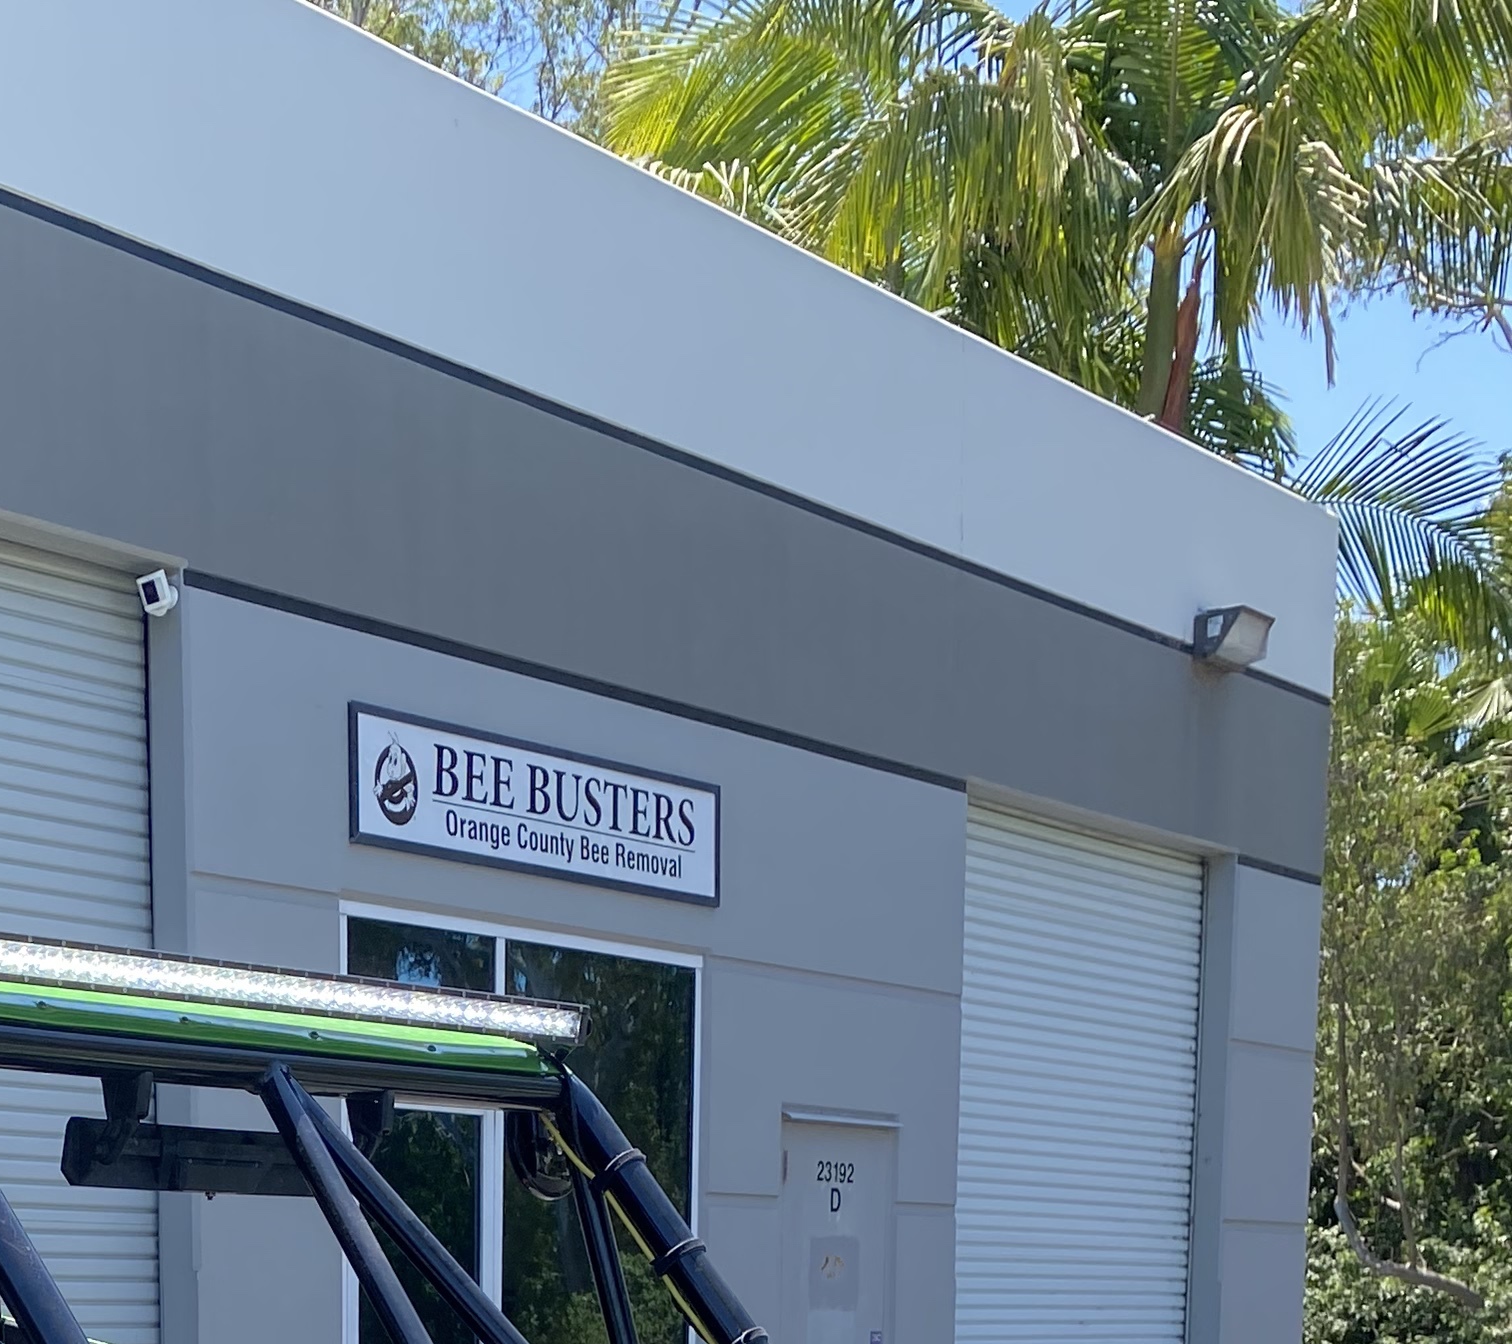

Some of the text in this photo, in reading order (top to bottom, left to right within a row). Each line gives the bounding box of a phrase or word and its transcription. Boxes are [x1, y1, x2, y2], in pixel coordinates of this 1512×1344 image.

[432, 743, 695, 846] BEE BUSTERS
[445, 809, 682, 878] Orange County Bee Removal
[816, 1160, 855, 1184] 23192
[830, 1187, 842, 1213] D
